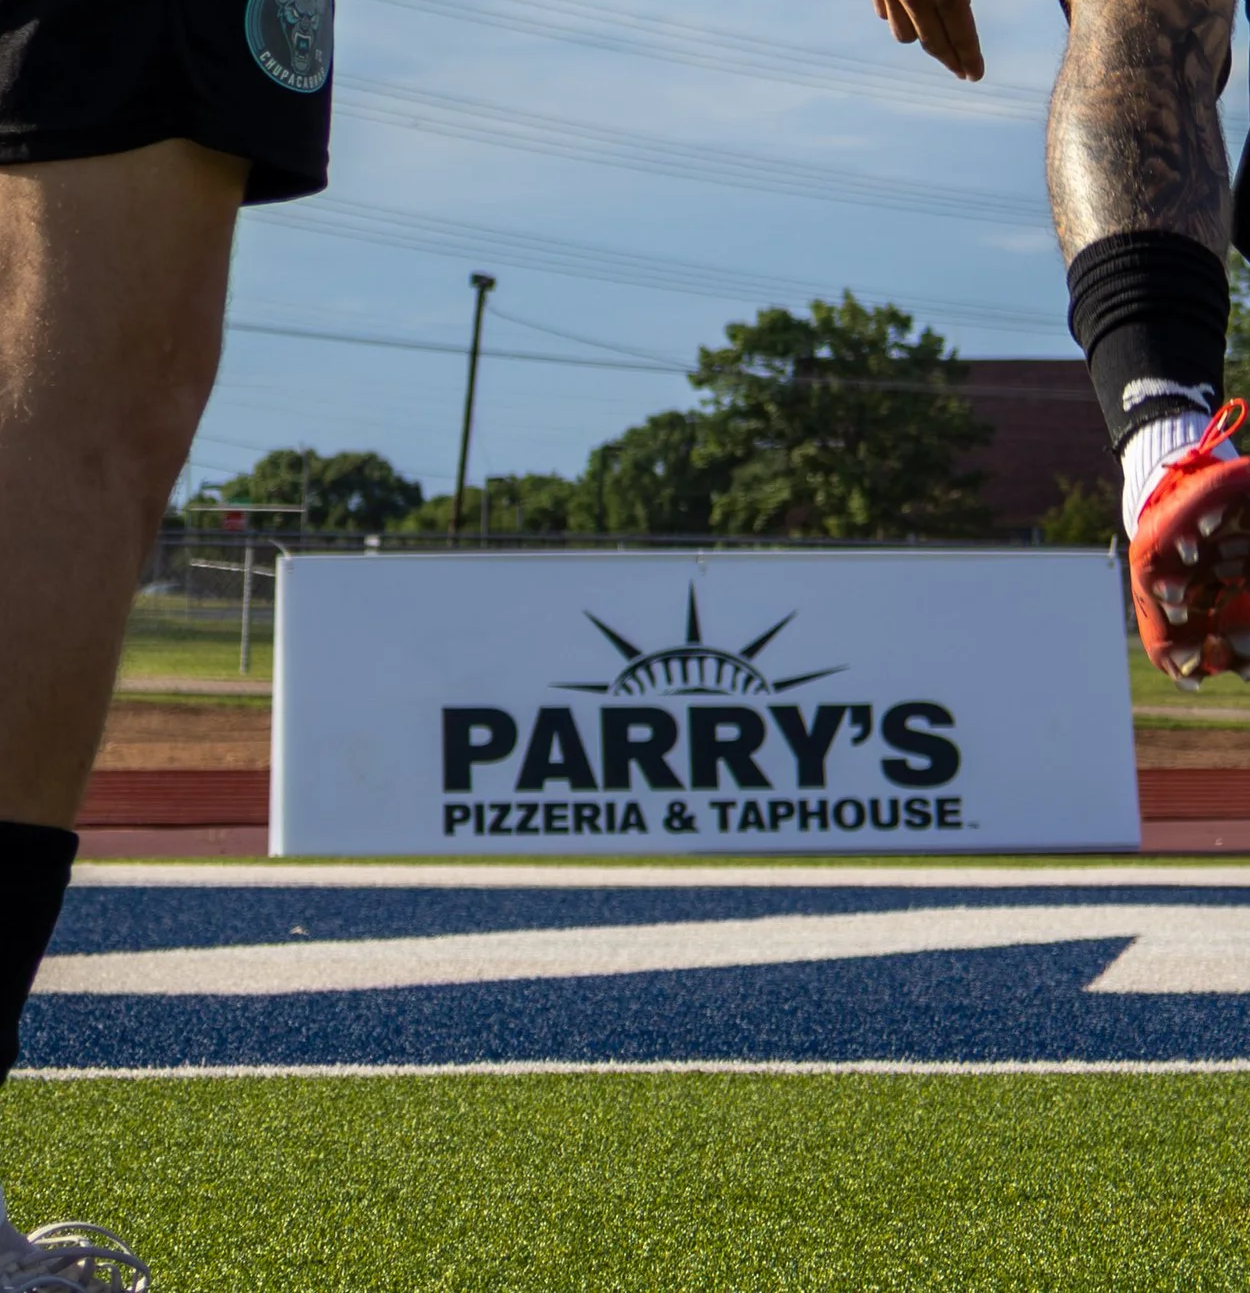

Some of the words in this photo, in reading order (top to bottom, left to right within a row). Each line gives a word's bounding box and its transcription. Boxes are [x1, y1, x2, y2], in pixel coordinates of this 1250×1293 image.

[441, 700, 962, 793] PARRY'S
[443, 799, 649, 837] PIZZERIA
[662, 800, 698, 834] &
[710, 796, 964, 834] TAPHOUSE
